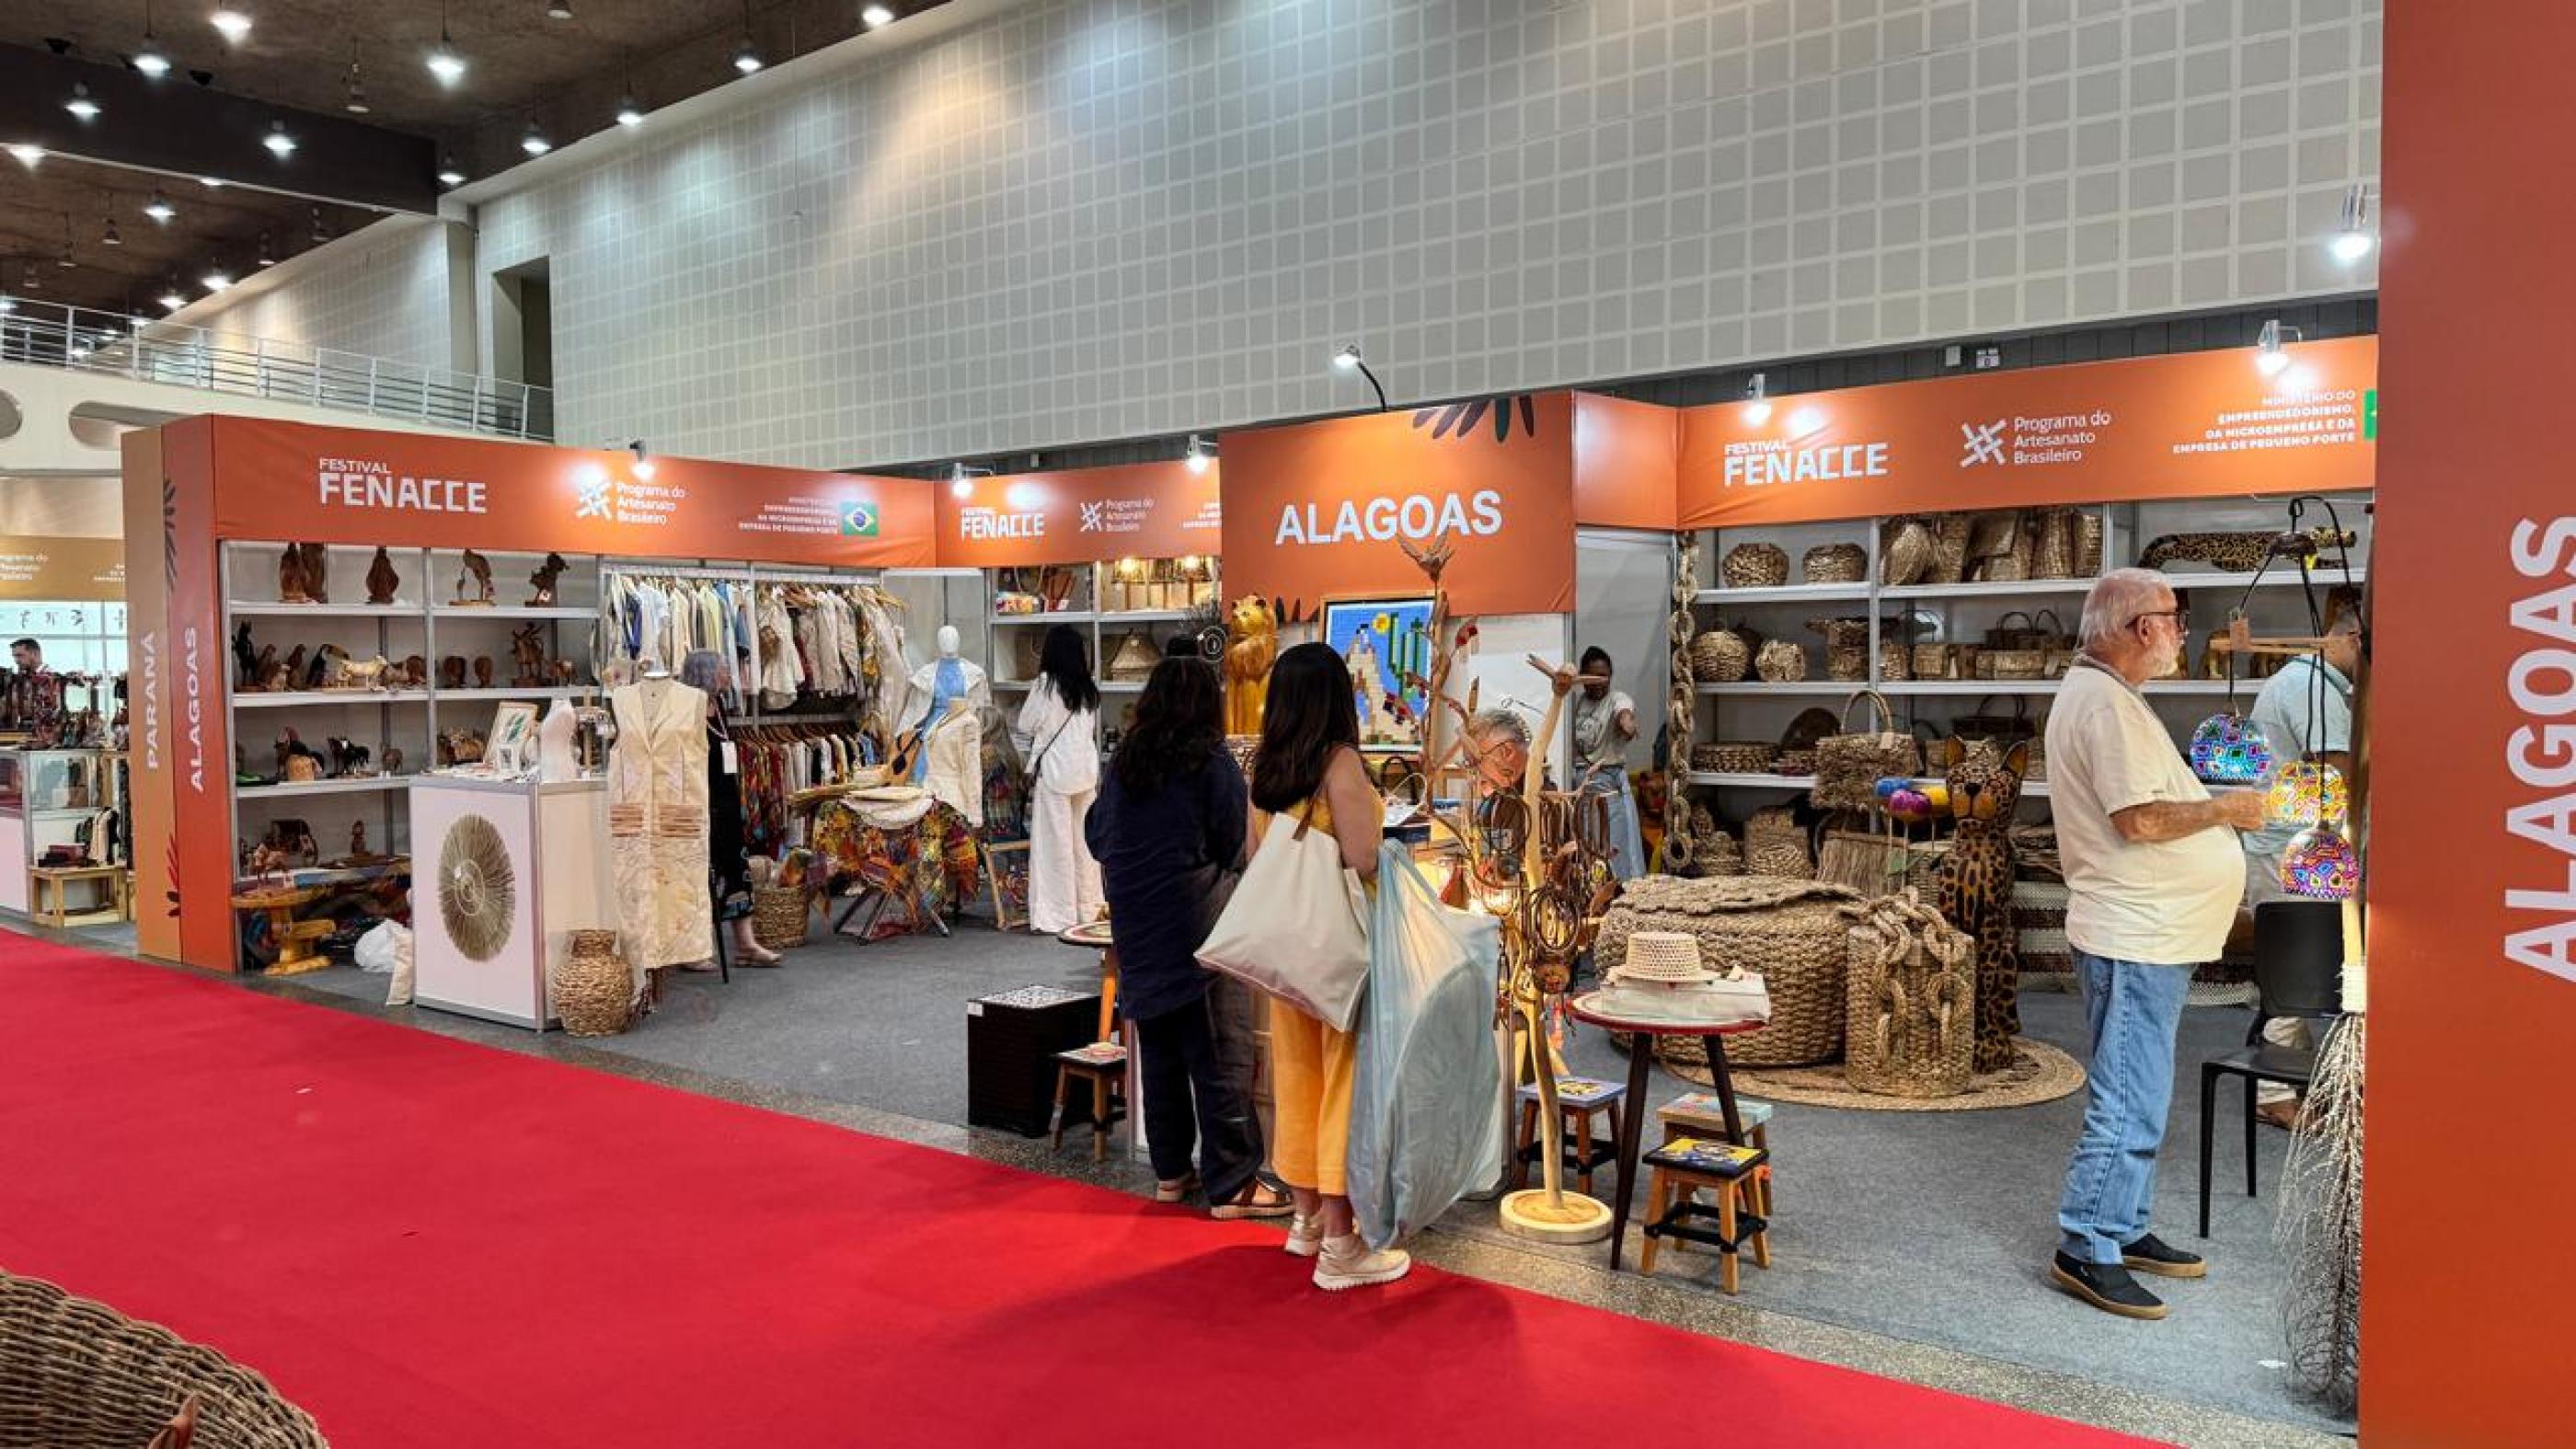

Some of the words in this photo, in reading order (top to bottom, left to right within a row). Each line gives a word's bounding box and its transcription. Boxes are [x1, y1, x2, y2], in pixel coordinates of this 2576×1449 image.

[2337, 390, 2355, 399] DO
[2014, 414, 2087, 433] Programa
[2091, 409, 2111, 425] do
[2205, 430, 2222, 439] DA
[2327, 420, 2335, 429] E
[2338, 418, 2355, 428] DA
[1725, 440, 1788, 454] FESTIVAL
[2014, 431, 2095, 447] Artesanato
[2173, 442, 2228, 454] EMPRESA
[2232, 441, 2247, 450] DE
[319, 457, 392, 474] FESTIVAL
[1724, 442, 1888, 487] FENACCE
[2014, 448, 2082, 464] Brasileiro
[319, 472, 487, 513] FENACCE
[961, 513, 1045, 540] FENACCE
[1275, 489, 1502, 546] ALAGOAS
[141, 632, 158, 769] PARANÁ
[185, 627, 203, 793] ALAGOAS
[2504, 515, 2576, 983] ALAGOAS
